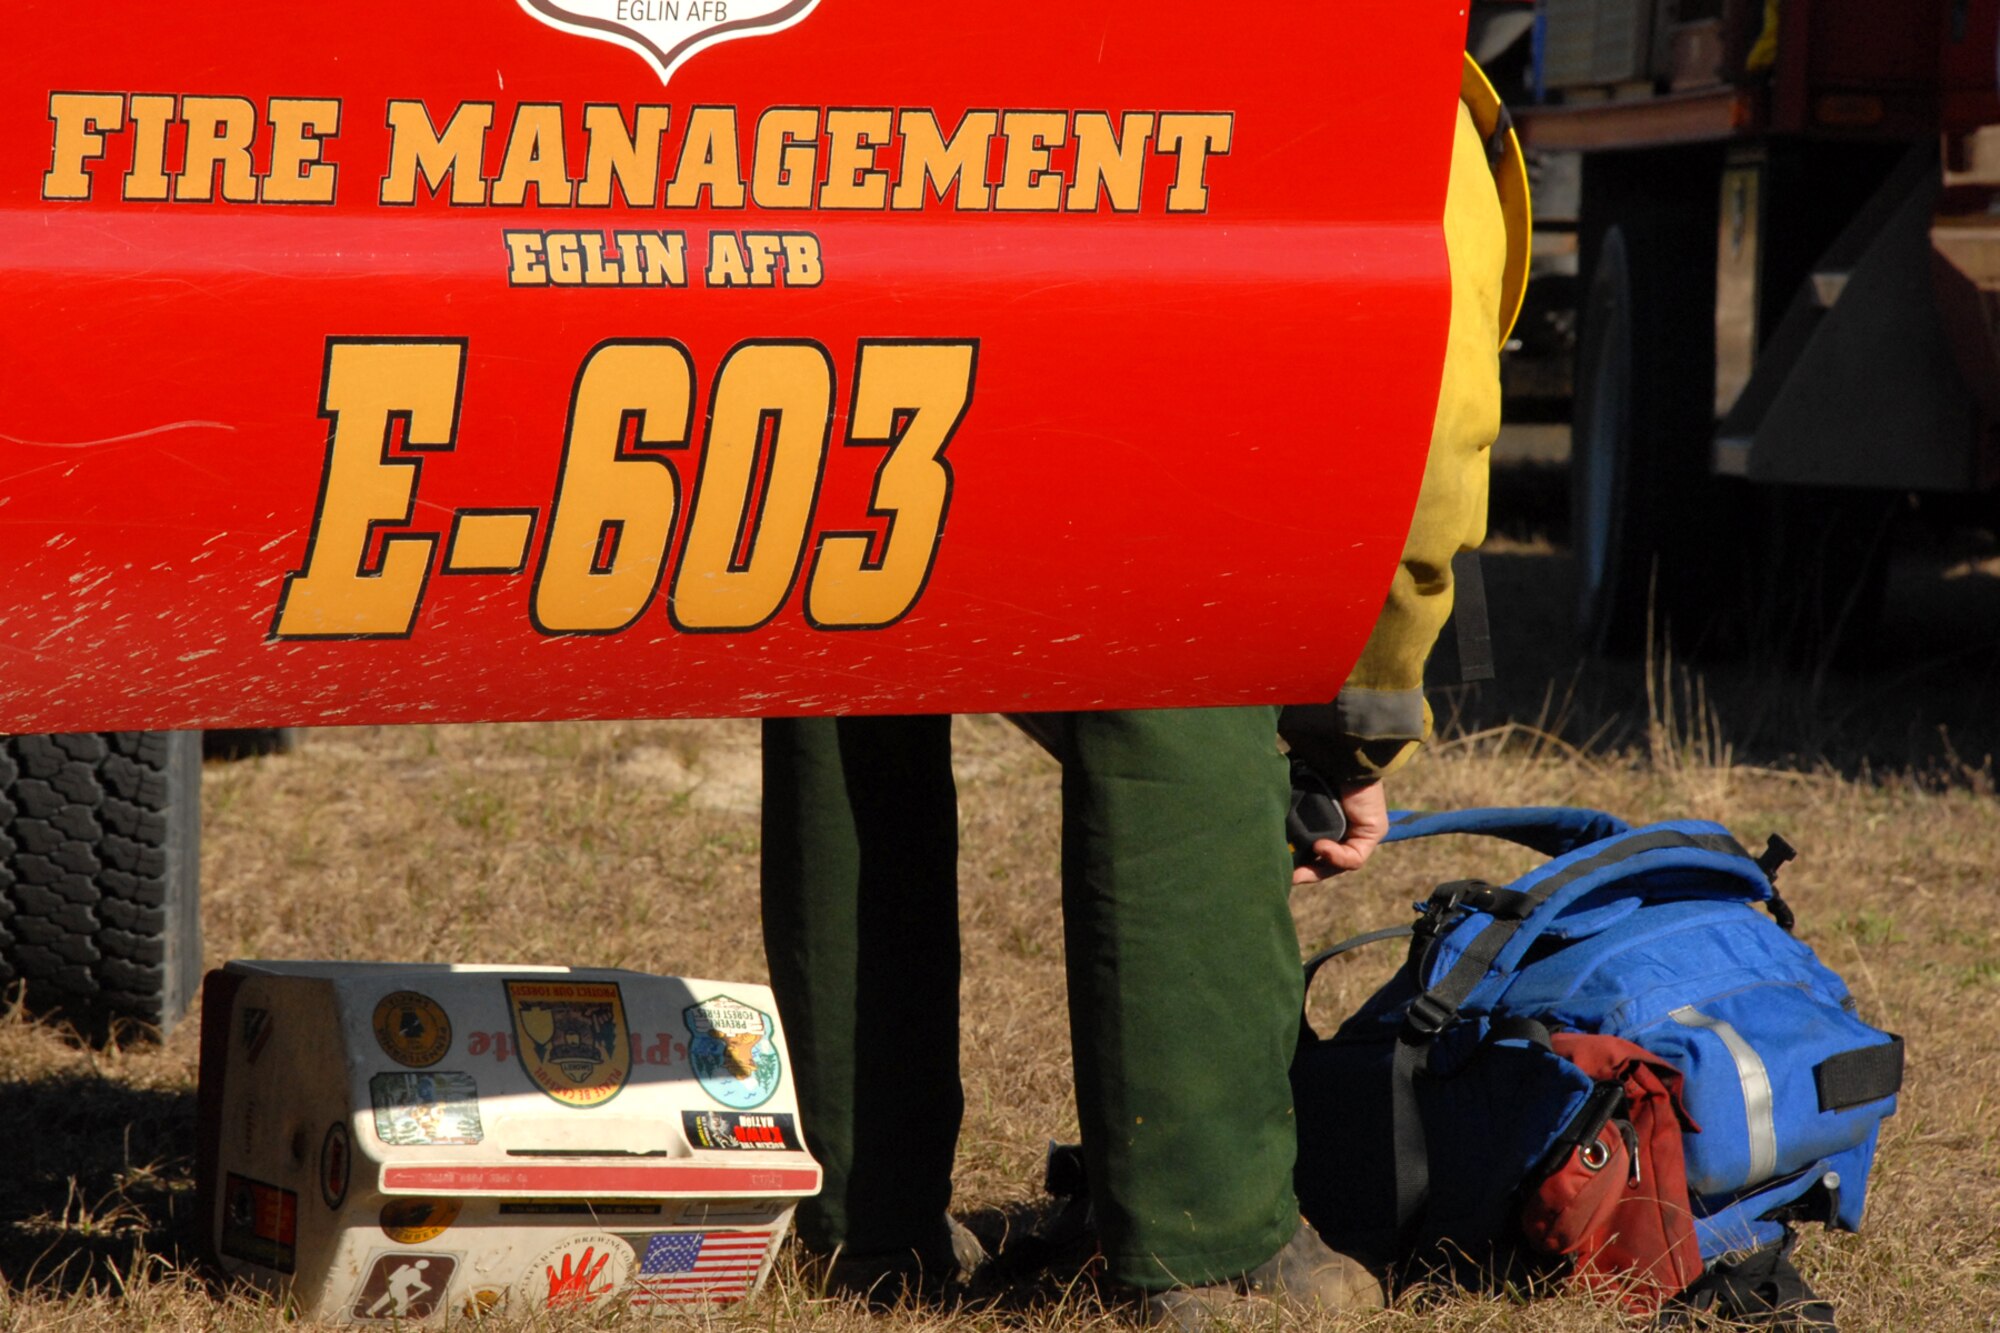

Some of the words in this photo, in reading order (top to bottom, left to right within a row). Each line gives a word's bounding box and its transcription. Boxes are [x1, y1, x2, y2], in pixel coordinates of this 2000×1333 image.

[616, 0, 679, 20] EGLIN
[686, 1, 727, 21] AFB
[41, 90, 342, 206] FIRE
[378, 98, 1234, 213] MANAGEMENT
[502, 229, 688, 288] EGLIN
[705, 230, 823, 288] AFB
[266, 334, 980, 642] E-603
[510, 985, 550, 996] FORESTS
[554, 986, 574, 997] OUR
[577, 986, 617, 998] PROTECT
[695, 1009, 721, 1019] FIRES
[722, 1009, 754, 1020] FOREST
[708, 1019, 747, 1029] PREVENT
[534, 1067, 575, 1099] CAREFUL
[593, 1068, 623, 1097] PLEASE
[579, 1089, 591, 1101] BE
[738, 1115, 774, 1127] NATION
